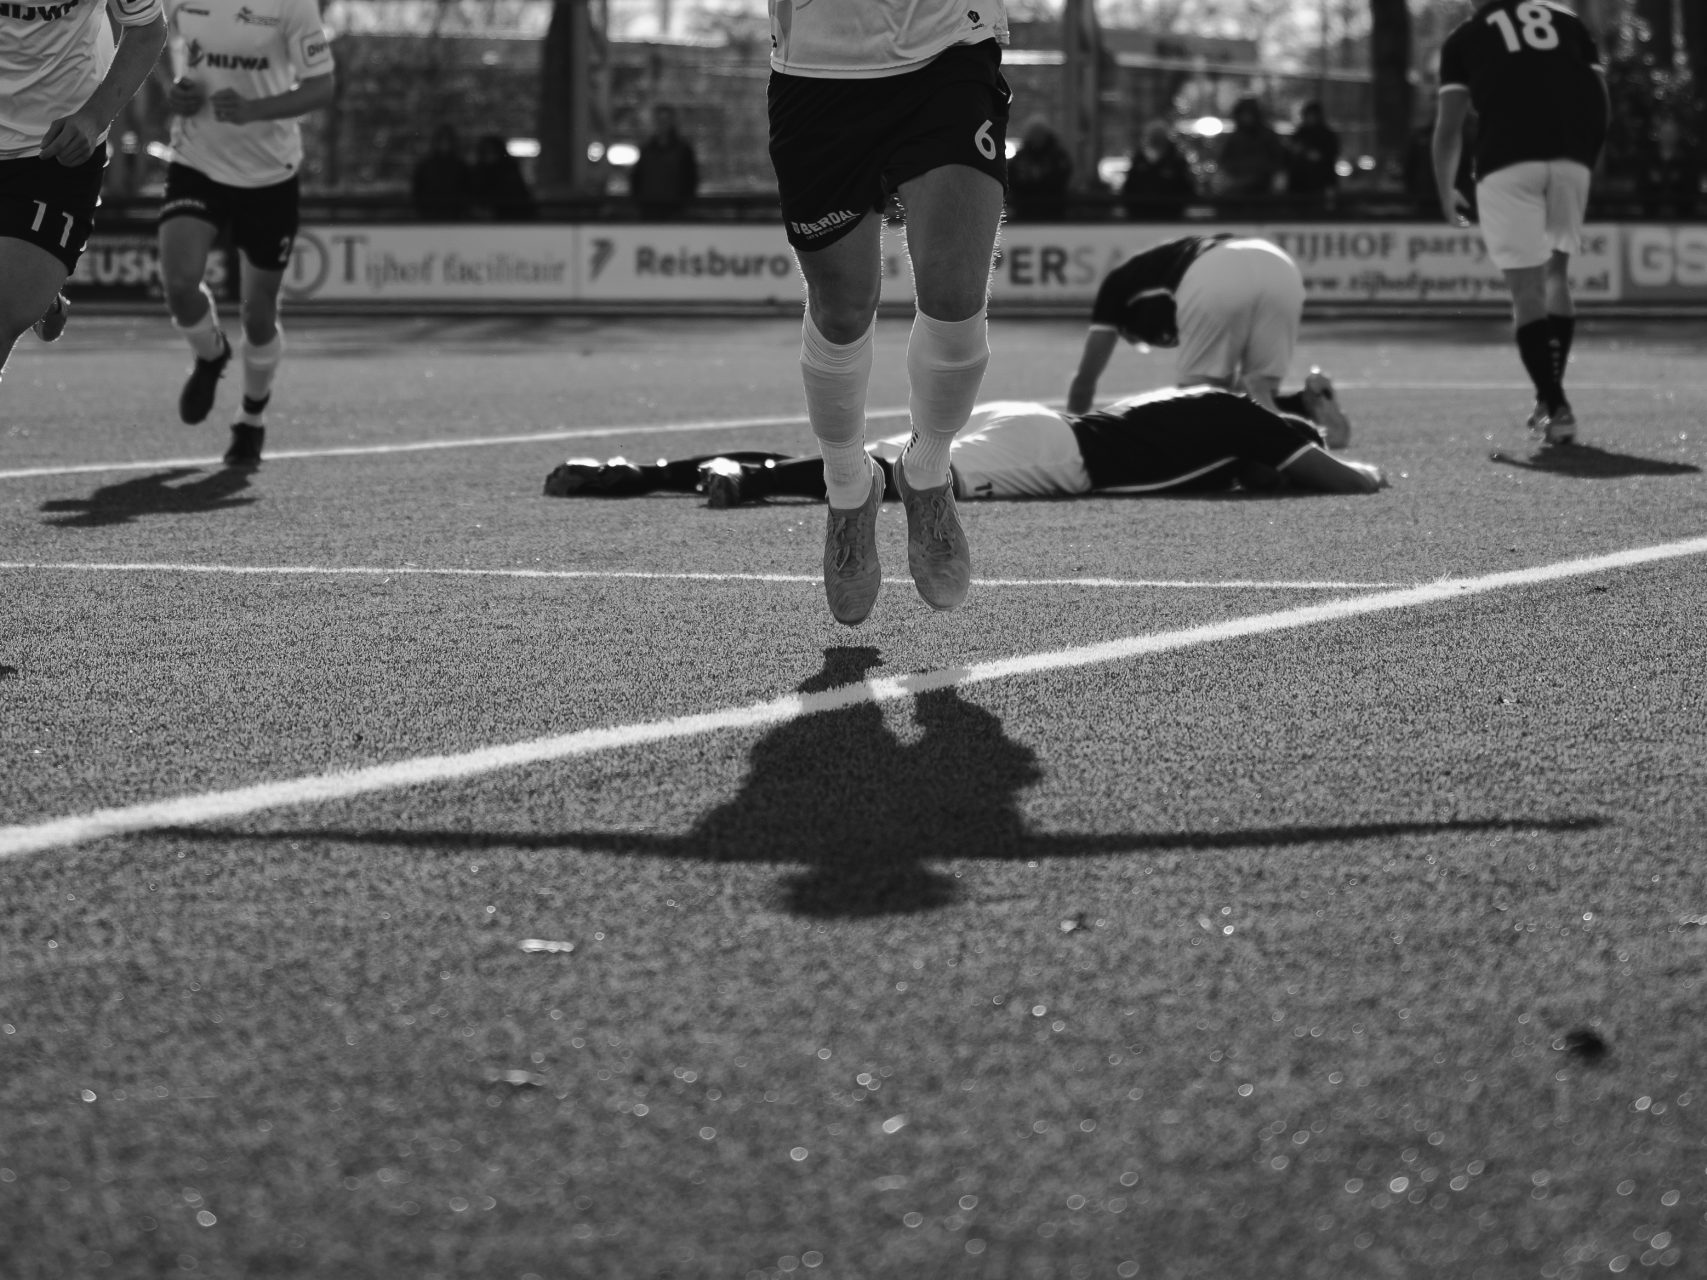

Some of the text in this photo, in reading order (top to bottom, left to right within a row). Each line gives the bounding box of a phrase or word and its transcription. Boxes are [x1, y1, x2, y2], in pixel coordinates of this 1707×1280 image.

[1486, 1, 1559, 53] 18
[974, 120, 997, 160] 6
[31, 200, 74, 249] 11
[635, 246, 791, 278] Reisburo
